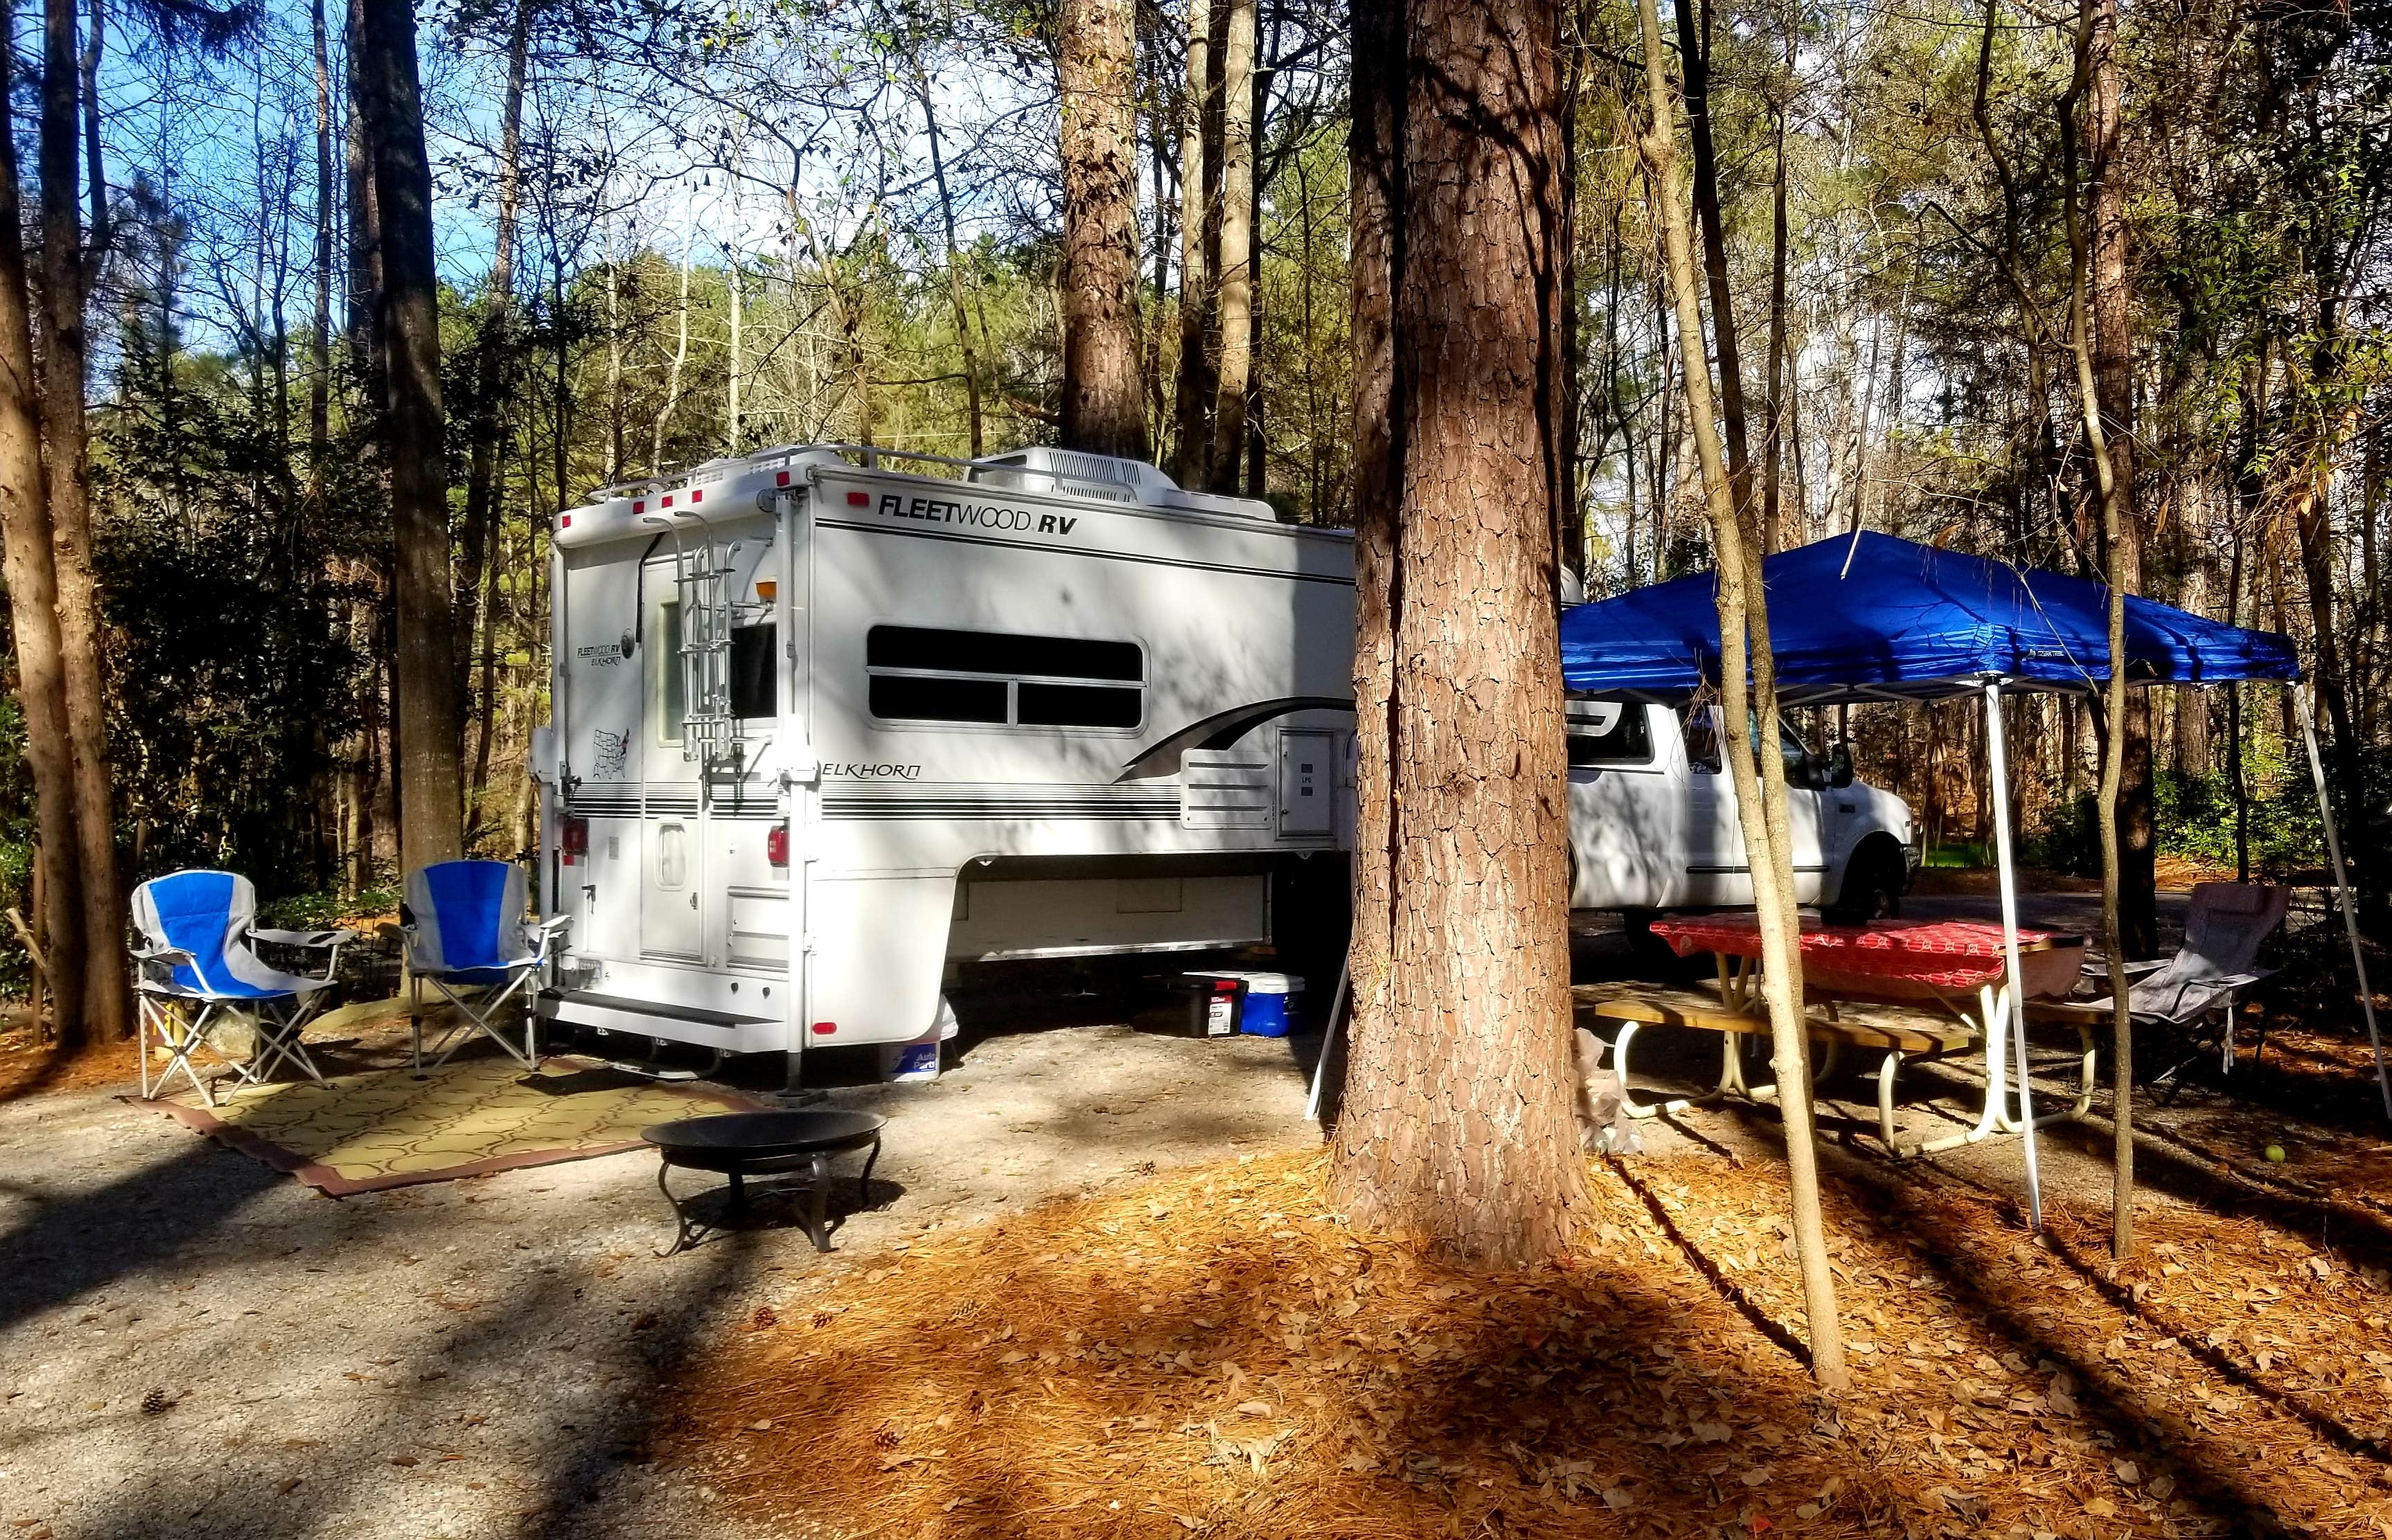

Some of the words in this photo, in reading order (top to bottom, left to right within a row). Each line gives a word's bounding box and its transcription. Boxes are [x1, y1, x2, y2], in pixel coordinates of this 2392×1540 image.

[878, 494, 1031, 530] FLEETWOOD
[1037, 514, 1078, 535] RV
[611, 644, 621, 653] RV
[591, 656, 621, 667] ELKHORN
[821, 763, 922, 780] ELKHORN
